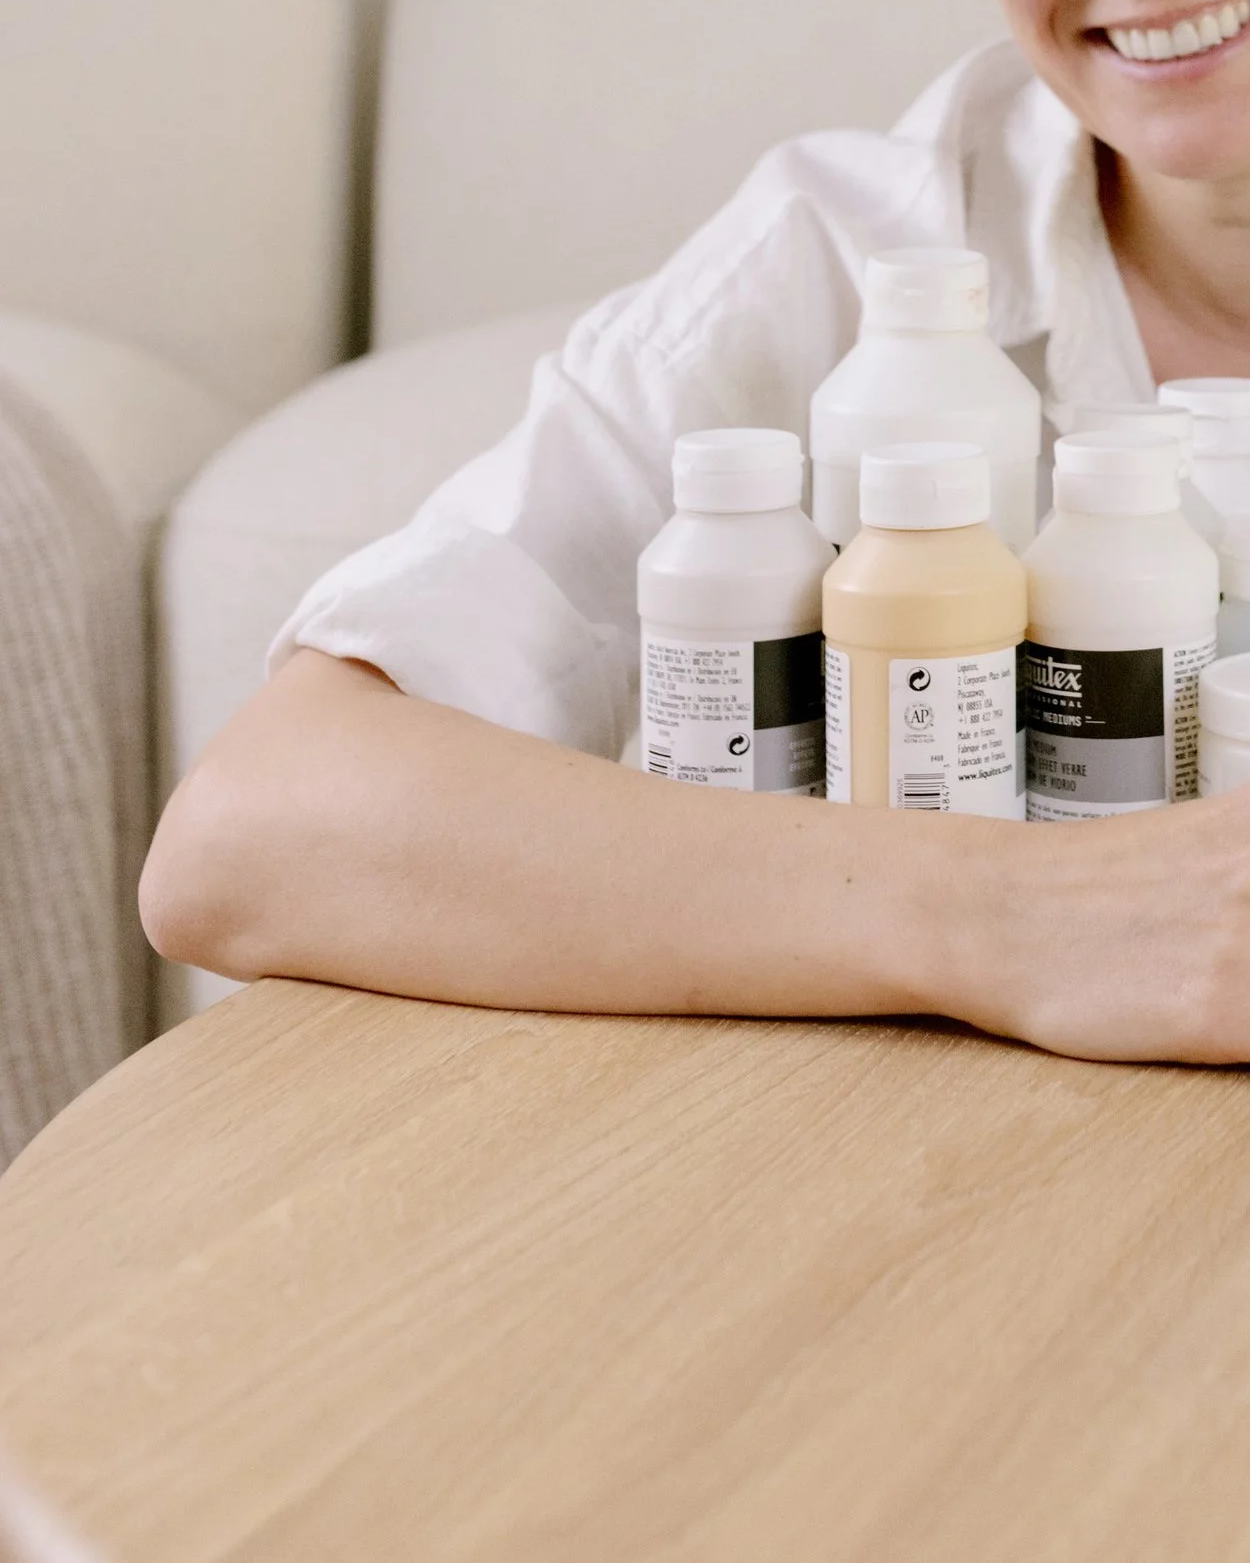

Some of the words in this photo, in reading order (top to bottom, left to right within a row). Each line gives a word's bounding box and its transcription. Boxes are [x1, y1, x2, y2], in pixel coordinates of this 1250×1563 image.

[910, 709, 929, 724] AP
[1042, 711, 1083, 727] MEDIUMS
[957, 764, 1013, 781] www.liquitex.com
[1060, 762, 1087, 778] VERRE
